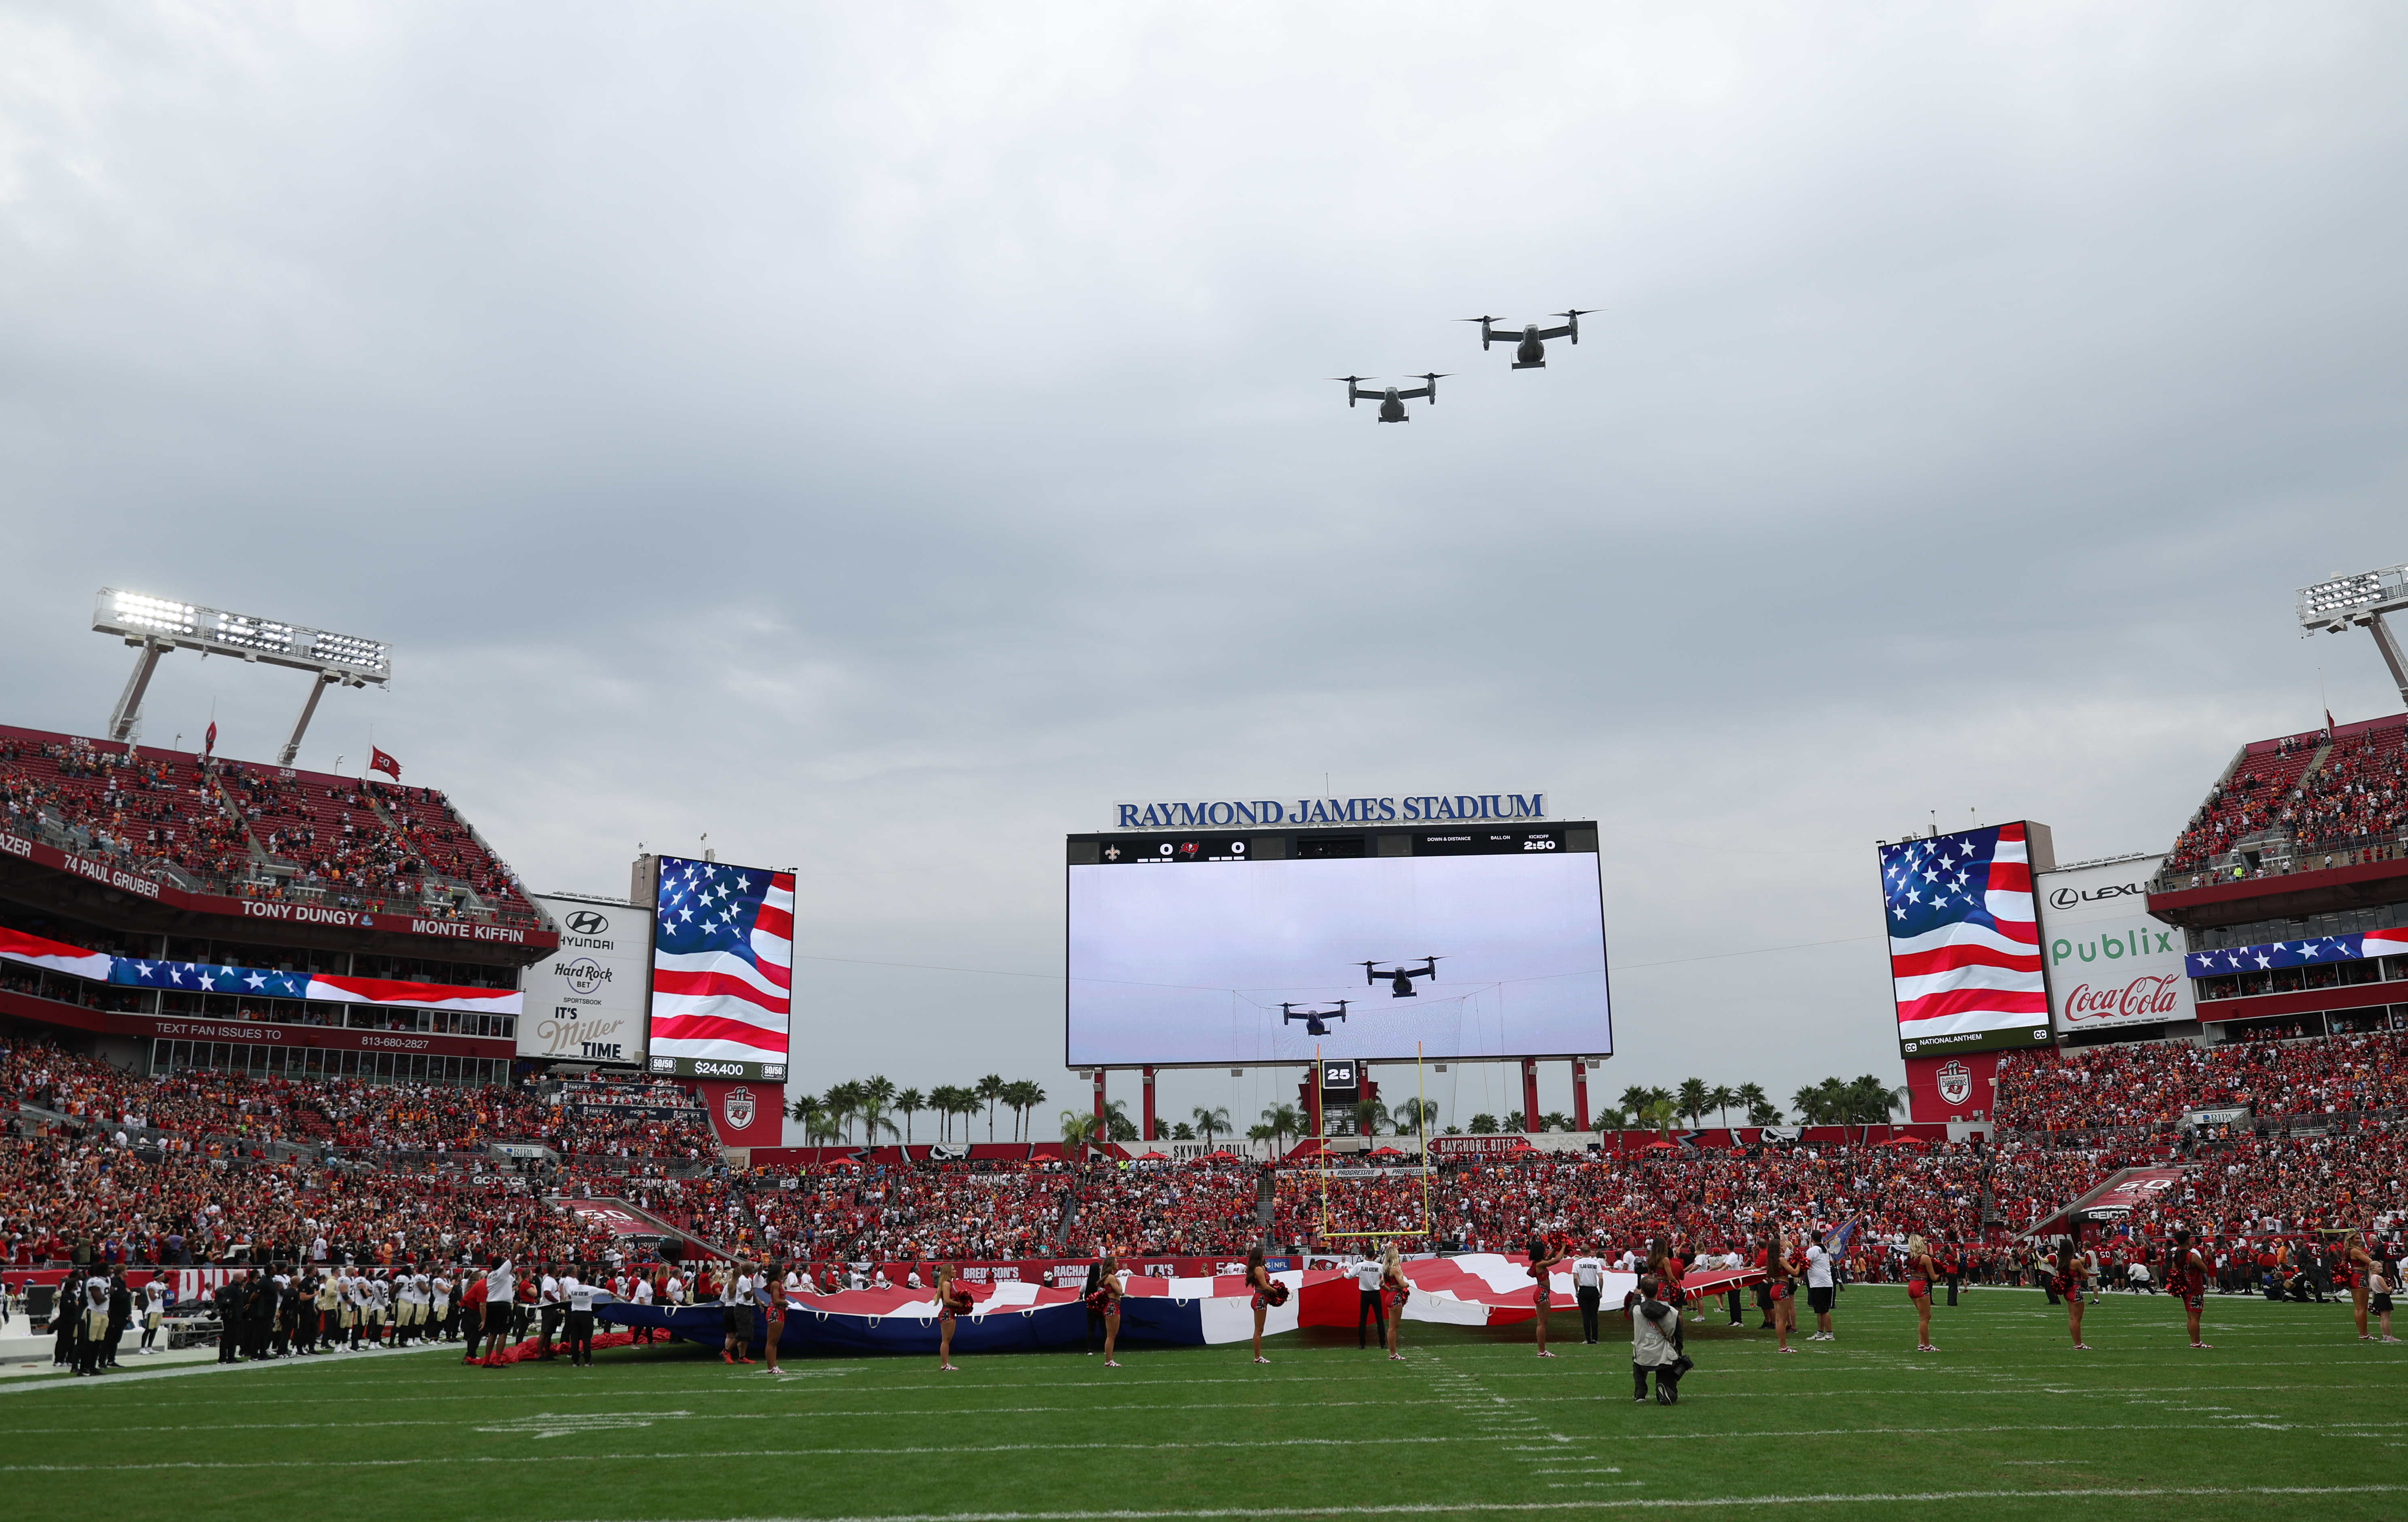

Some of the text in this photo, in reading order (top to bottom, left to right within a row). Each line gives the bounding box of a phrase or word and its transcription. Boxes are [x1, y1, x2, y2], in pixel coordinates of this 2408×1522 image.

[70, 737, 89, 747] 329
[280, 769, 296, 778] 328
[1118, 794, 1545, 827] RAYMOND JAMES STADIUM
[1160, 844, 1173, 855] 0
[1231, 842, 1245, 854] 0
[1524, 841, 1555, 850] 2:50
[64, 854, 159, 899] 74 PAUL GRUBER
[2082, 882, 2147, 901] LEXU
[242, 901, 359, 926] TONY DUNGY
[412, 919, 524, 943] MONTE KIFFIN
[561, 936, 614, 950] HYUNDAI
[554, 963, 613, 982] Hard Rock
[563, 997, 602, 1005] SPORTSBOOK
[2065, 973, 2181, 1021] Coca-Cola
[156, 1022, 282, 1040] TEXT FAN ISSUES TO
[537, 1018, 625, 1054] Miller
[362, 1036, 429, 1049] 813-680-2827
[1920, 1033, 1982, 1046] NATIONAL ANTHEM
[581, 1042, 622, 1059] TIME
[653, 1059, 673, 1068] 50/50
[695, 1060, 743, 1076] $24,400
[764, 1066, 783, 1075] 50/50
[1328, 1069, 1350, 1080] 25
[1942, 1079, 1967, 1087] CHAMPIONS
[2211, 1113, 2233, 1123] RIPA
[1441, 1138, 1517, 1153] BAYSHORE BITES
[514, 1148, 533, 1157] RIPA
[2114, 1180, 2172, 1191] 50
[575, 1209, 634, 1220] 50
[2088, 1210, 2130, 1219] GEICO
[2311, 1246, 2321, 1255] 43
[2387, 1246, 2396, 1255] 45
[963, 1267, 1019, 1279] BREDSON'S
[1144, 1264, 1173, 1276] VIA'S
[1216, 1262, 1233, 1276] 5
